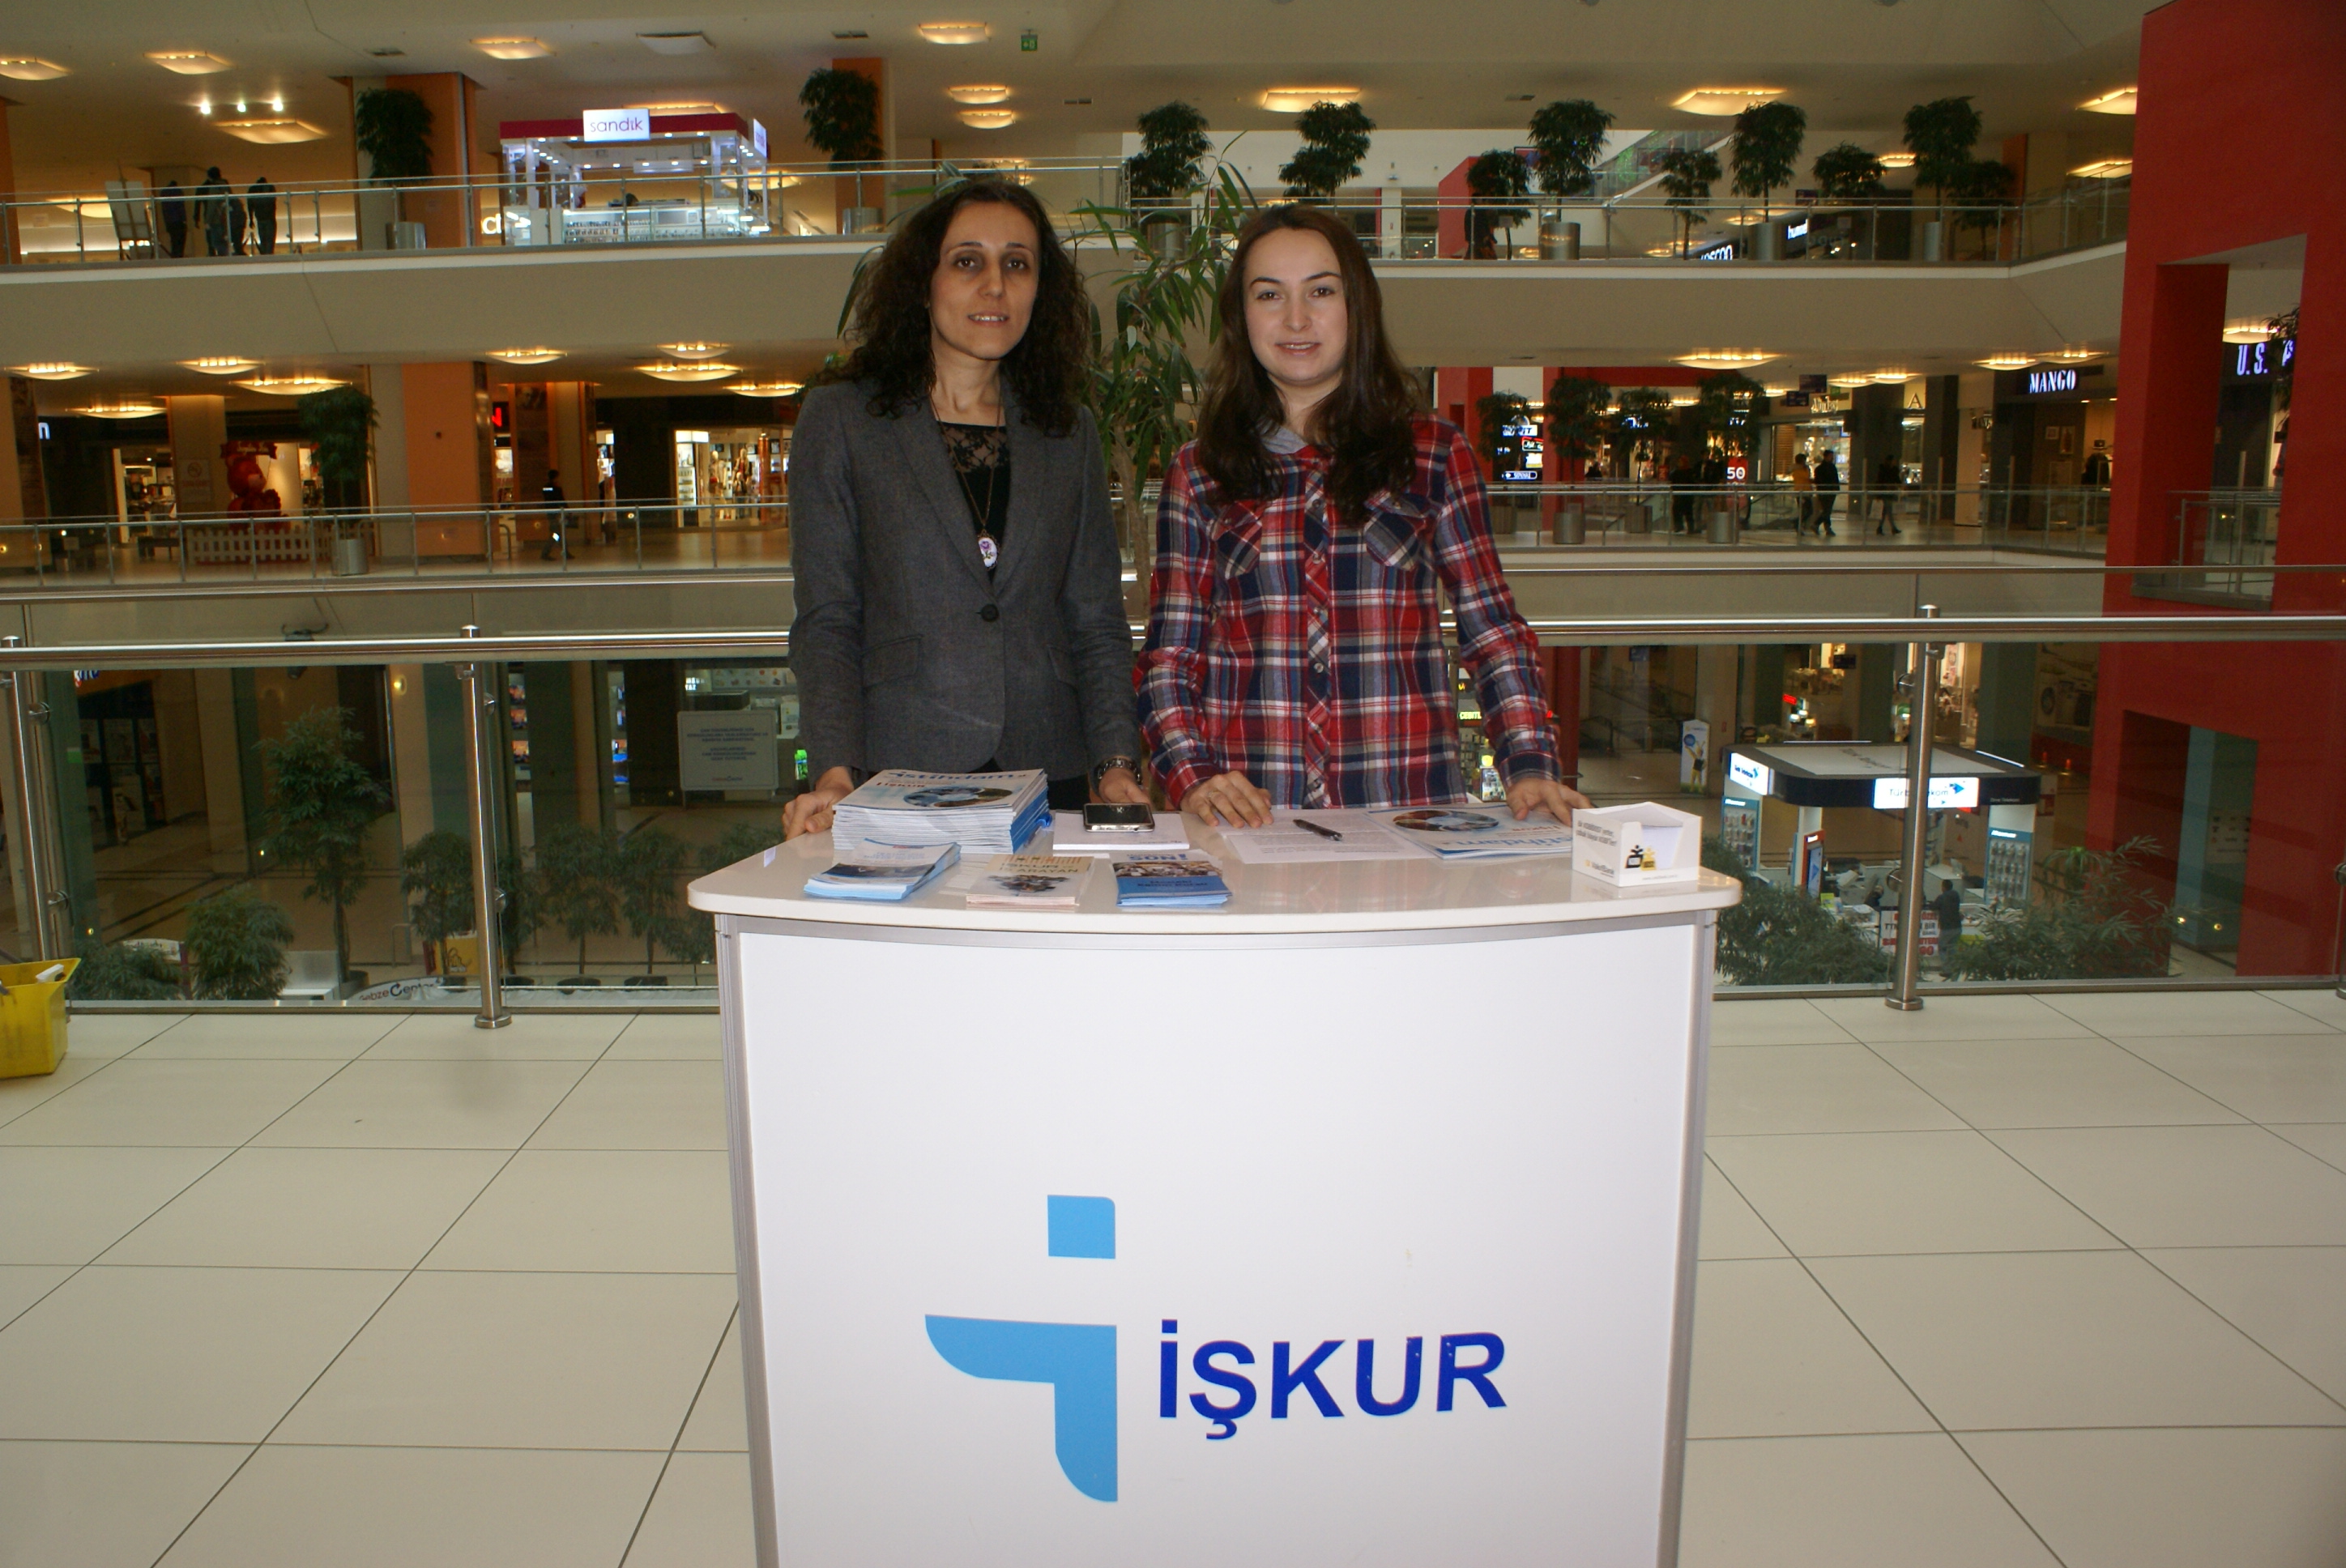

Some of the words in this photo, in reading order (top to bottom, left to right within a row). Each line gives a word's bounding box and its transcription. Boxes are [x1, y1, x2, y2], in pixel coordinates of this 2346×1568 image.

[2029, 369, 2077, 394] MANGO
[1726, 467, 1746, 479] 50
[1158, 1319, 1508, 1440] İŞKUR
